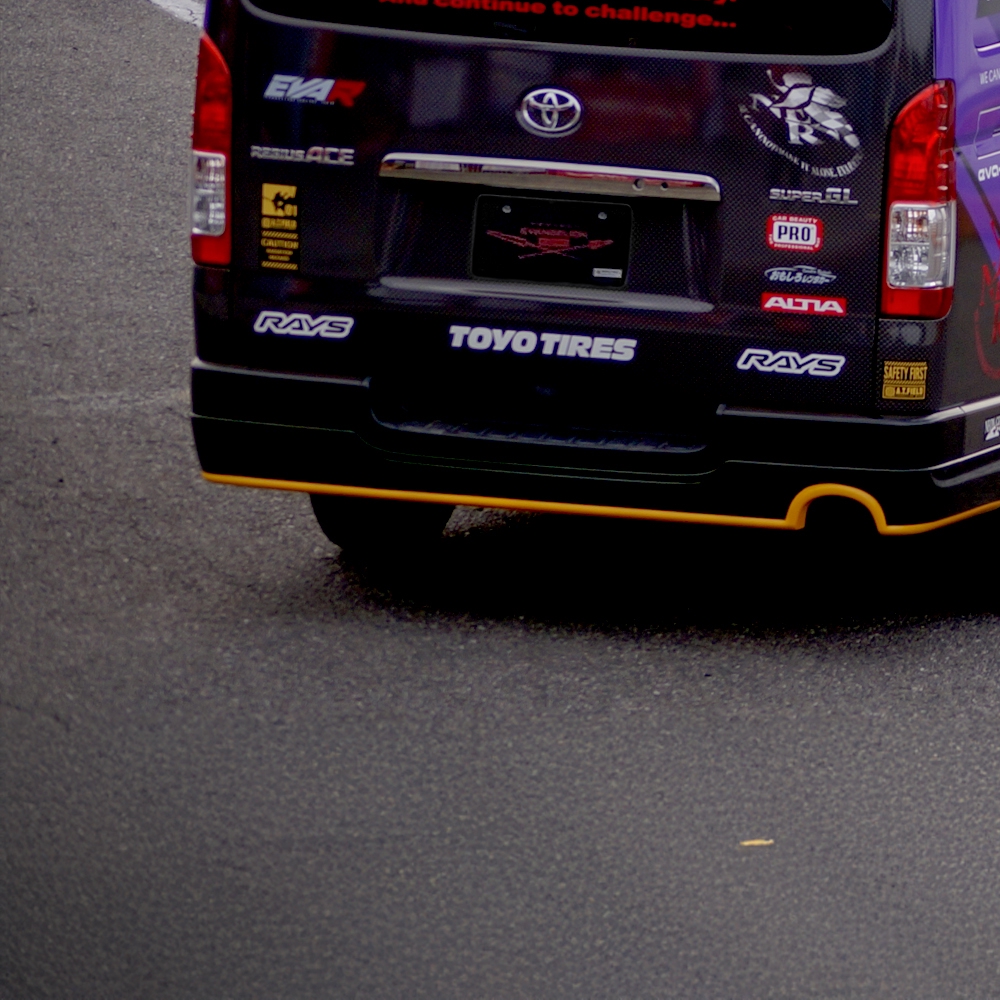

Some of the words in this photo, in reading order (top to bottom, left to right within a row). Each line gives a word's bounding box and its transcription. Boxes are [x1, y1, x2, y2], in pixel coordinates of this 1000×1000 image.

[552, 1, 579, 17] to
[584, 4, 737, 28] challenge...
[979, 70, 989, 85] WE
[989, 69, 1000, 82] CAN
[769, 188, 822, 203] SUPER
[824, 187, 859, 205] GL
[789, 215, 818, 224] BEAUTY
[778, 225, 812, 242] PRO
[764, 296, 844, 314] ALTIA
[254, 310, 354, 339] RAYS
[449, 325, 537, 354] TOYO
[540, 332, 637, 361] TIRES
[736, 348, 846, 377] RAYS
[883, 366, 909, 380] SAFETY
[909, 366, 928, 380] FIRST
